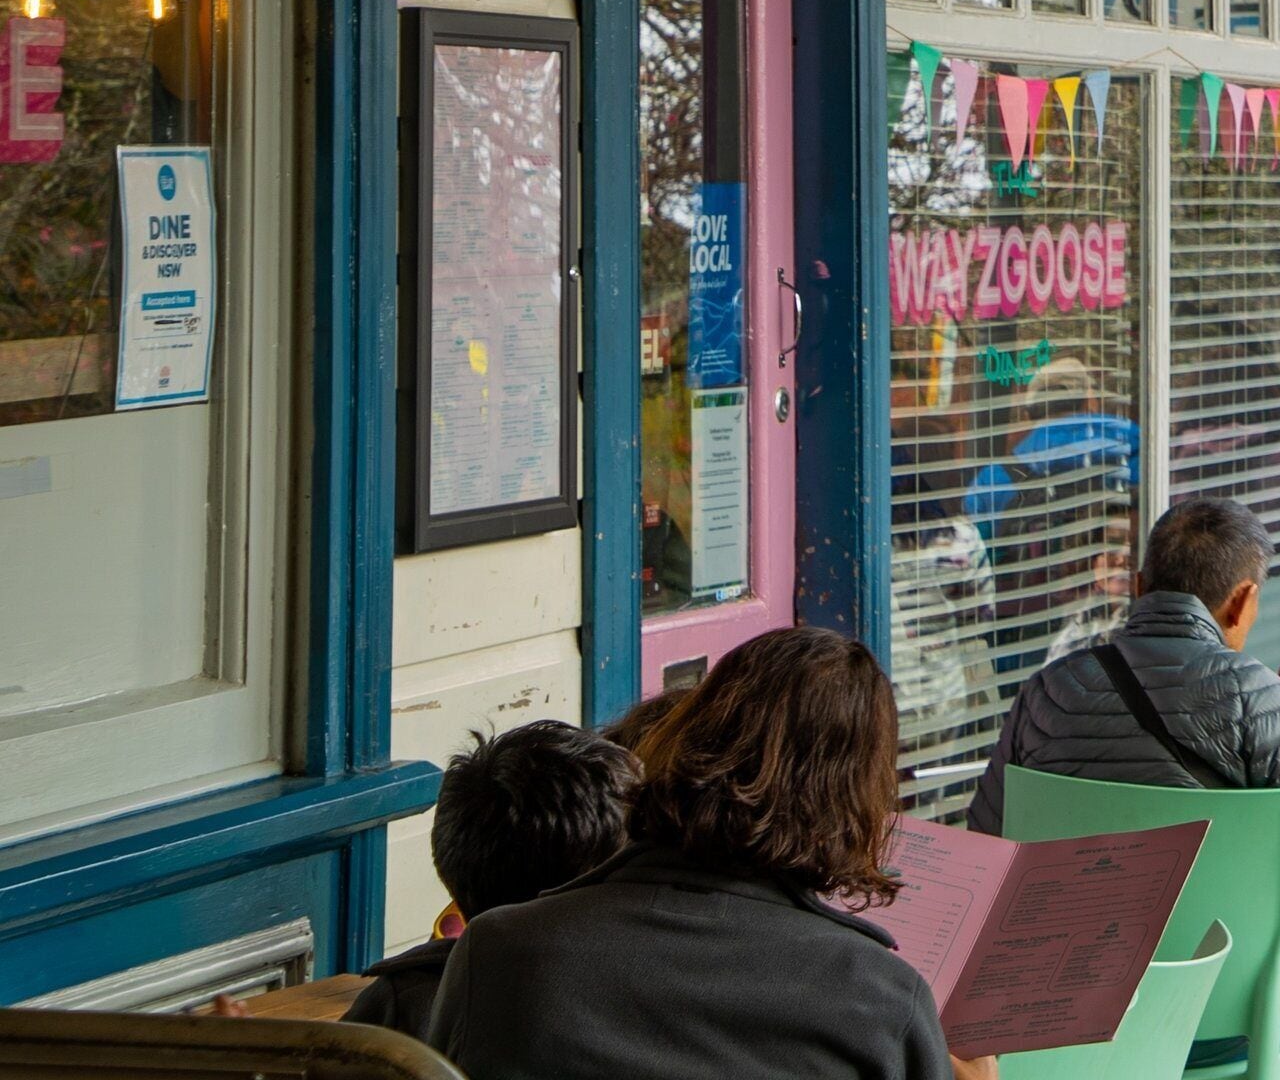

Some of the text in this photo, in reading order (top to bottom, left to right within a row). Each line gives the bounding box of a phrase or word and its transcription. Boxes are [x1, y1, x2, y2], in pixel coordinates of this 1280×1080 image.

[992, 160, 1038, 198] THE
[149, 215, 190, 240] DINE
[158, 263, 182, 278] NSW
[690, 245, 732, 274] LOCAL
[890, 222, 1127, 326] WAYZGOOSE
